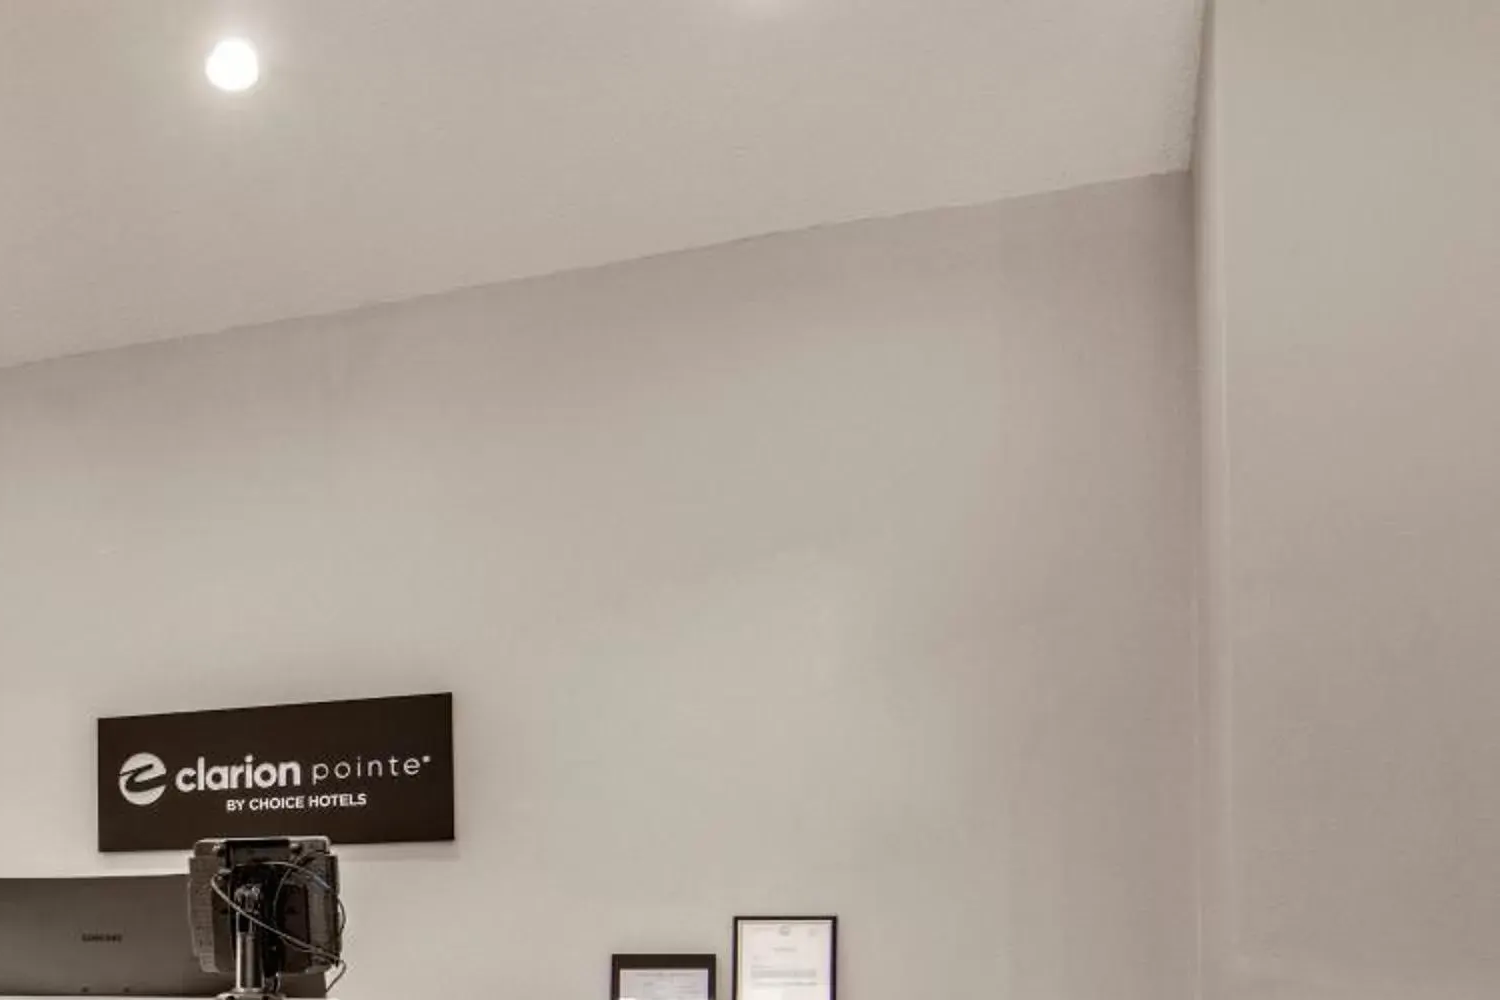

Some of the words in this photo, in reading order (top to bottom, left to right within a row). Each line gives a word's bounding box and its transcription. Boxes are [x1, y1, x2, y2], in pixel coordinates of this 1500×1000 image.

[175, 754, 301, 792] clarion
[226, 799, 245, 811] BY
[249, 796, 305, 810] CHOICE
[308, 793, 367, 808] HOTELS
